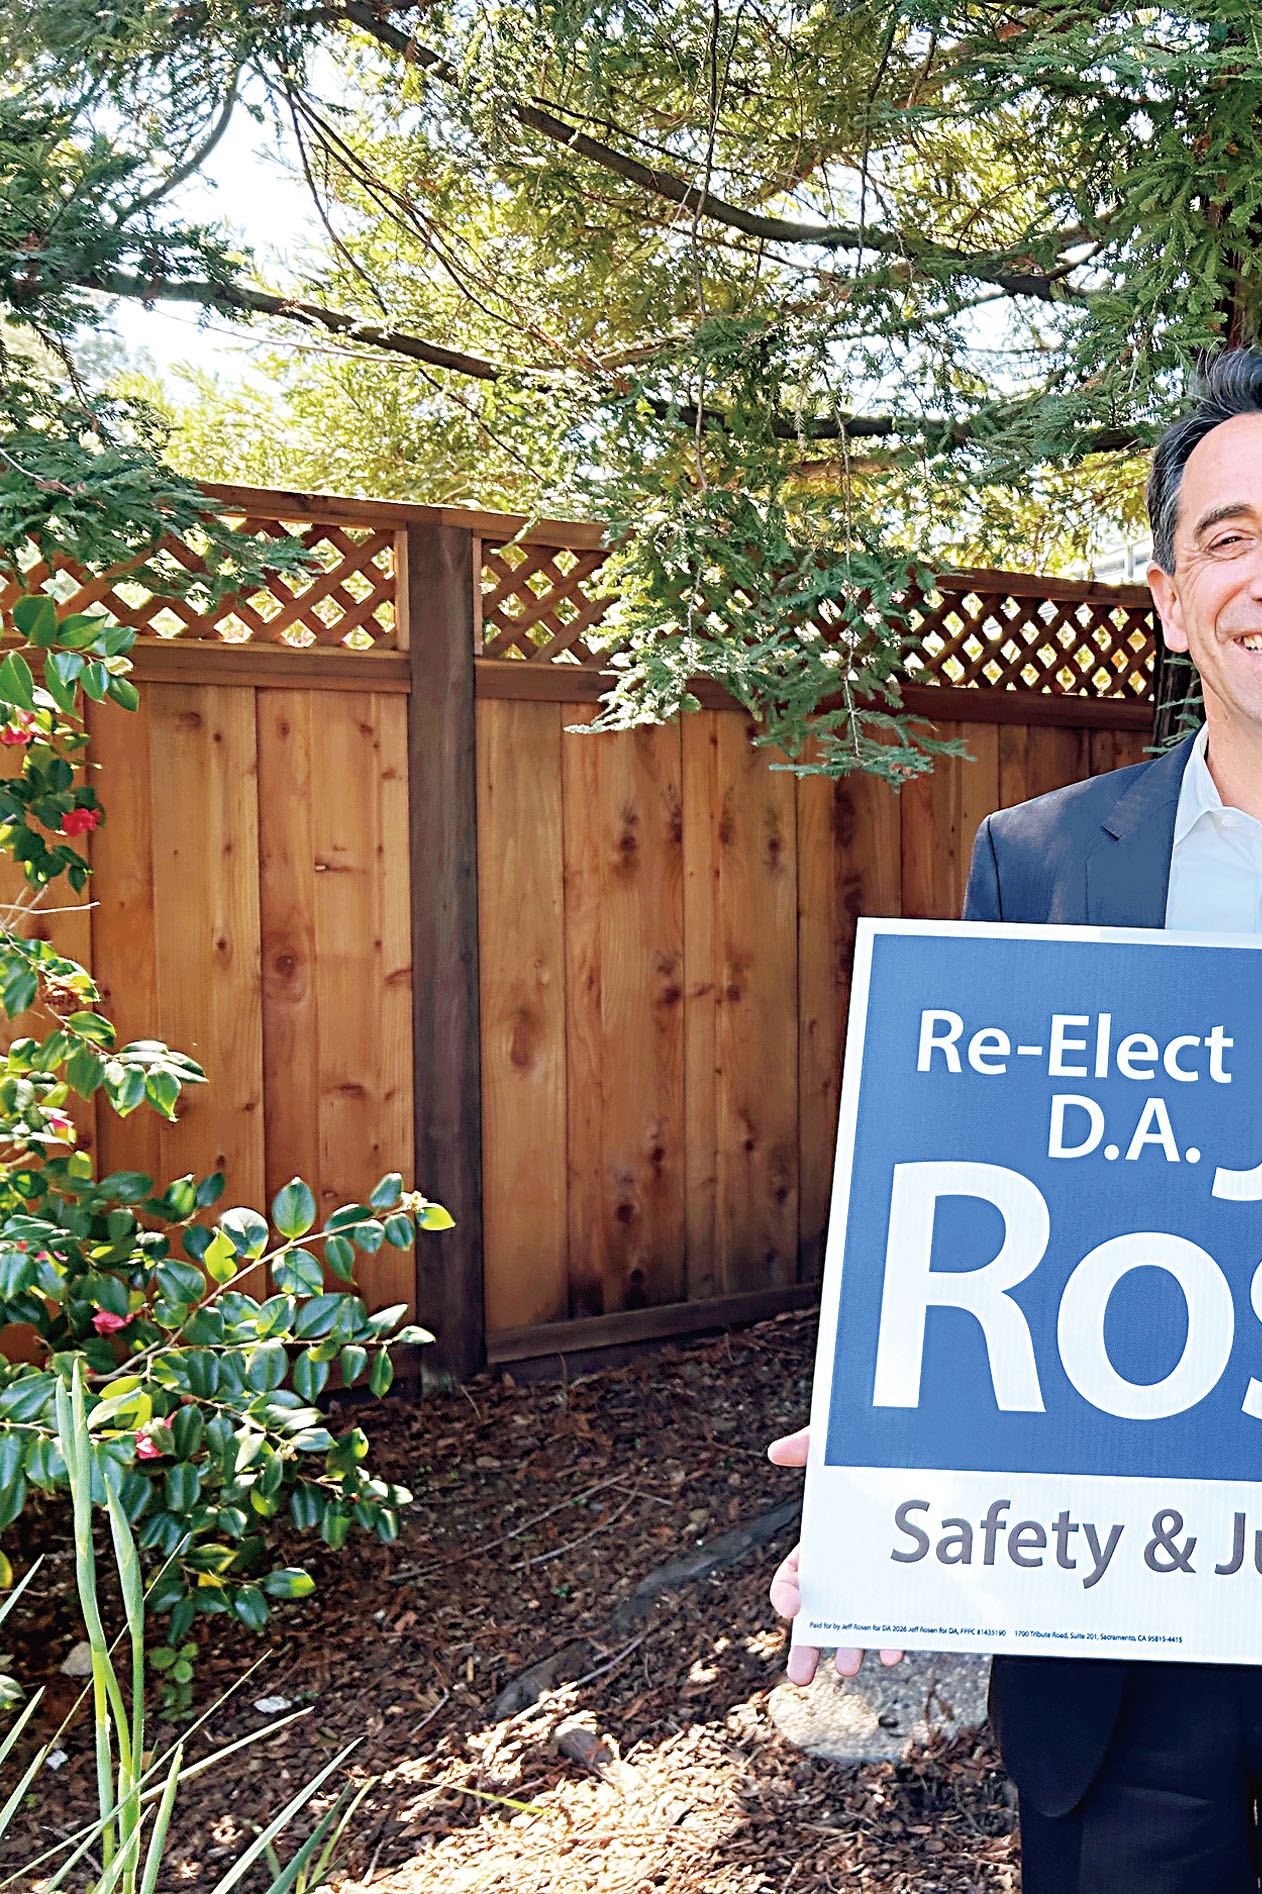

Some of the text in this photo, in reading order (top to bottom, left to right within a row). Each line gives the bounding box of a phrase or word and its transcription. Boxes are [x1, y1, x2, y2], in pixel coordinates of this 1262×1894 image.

[917, 1010, 1233, 1083] Re-Elect
[1048, 1095, 1200, 1163] D.A.
[890, 1499, 1125, 1589] Safety
[1144, 1509, 1197, 1573] &
[809, 1621, 822, 1629] Paid
[833, 1623, 841, 1631] by
[853, 1623, 871, 1631] Rosen
[892, 1625, 907, 1633] 2026
[908, 1625, 919, 1633] Jeff
[919, 1626, 938, 1634] Rosen
[939, 1626, 948, 1634] for
[960, 1627, 976, 1635] FPPC
[1015, 1630, 1030, 1638] 1700
[1030, 1630, 1051, 1639] Tribute
[1052, 1631, 1069, 1640] Road,
[1070, 1631, 1086, 1640] Suite
[1086, 1632, 1099, 1641] 201,
[1100, 1633, 1136, 1642] Sacramento,
[1138, 1634, 1147, 1642] CA
